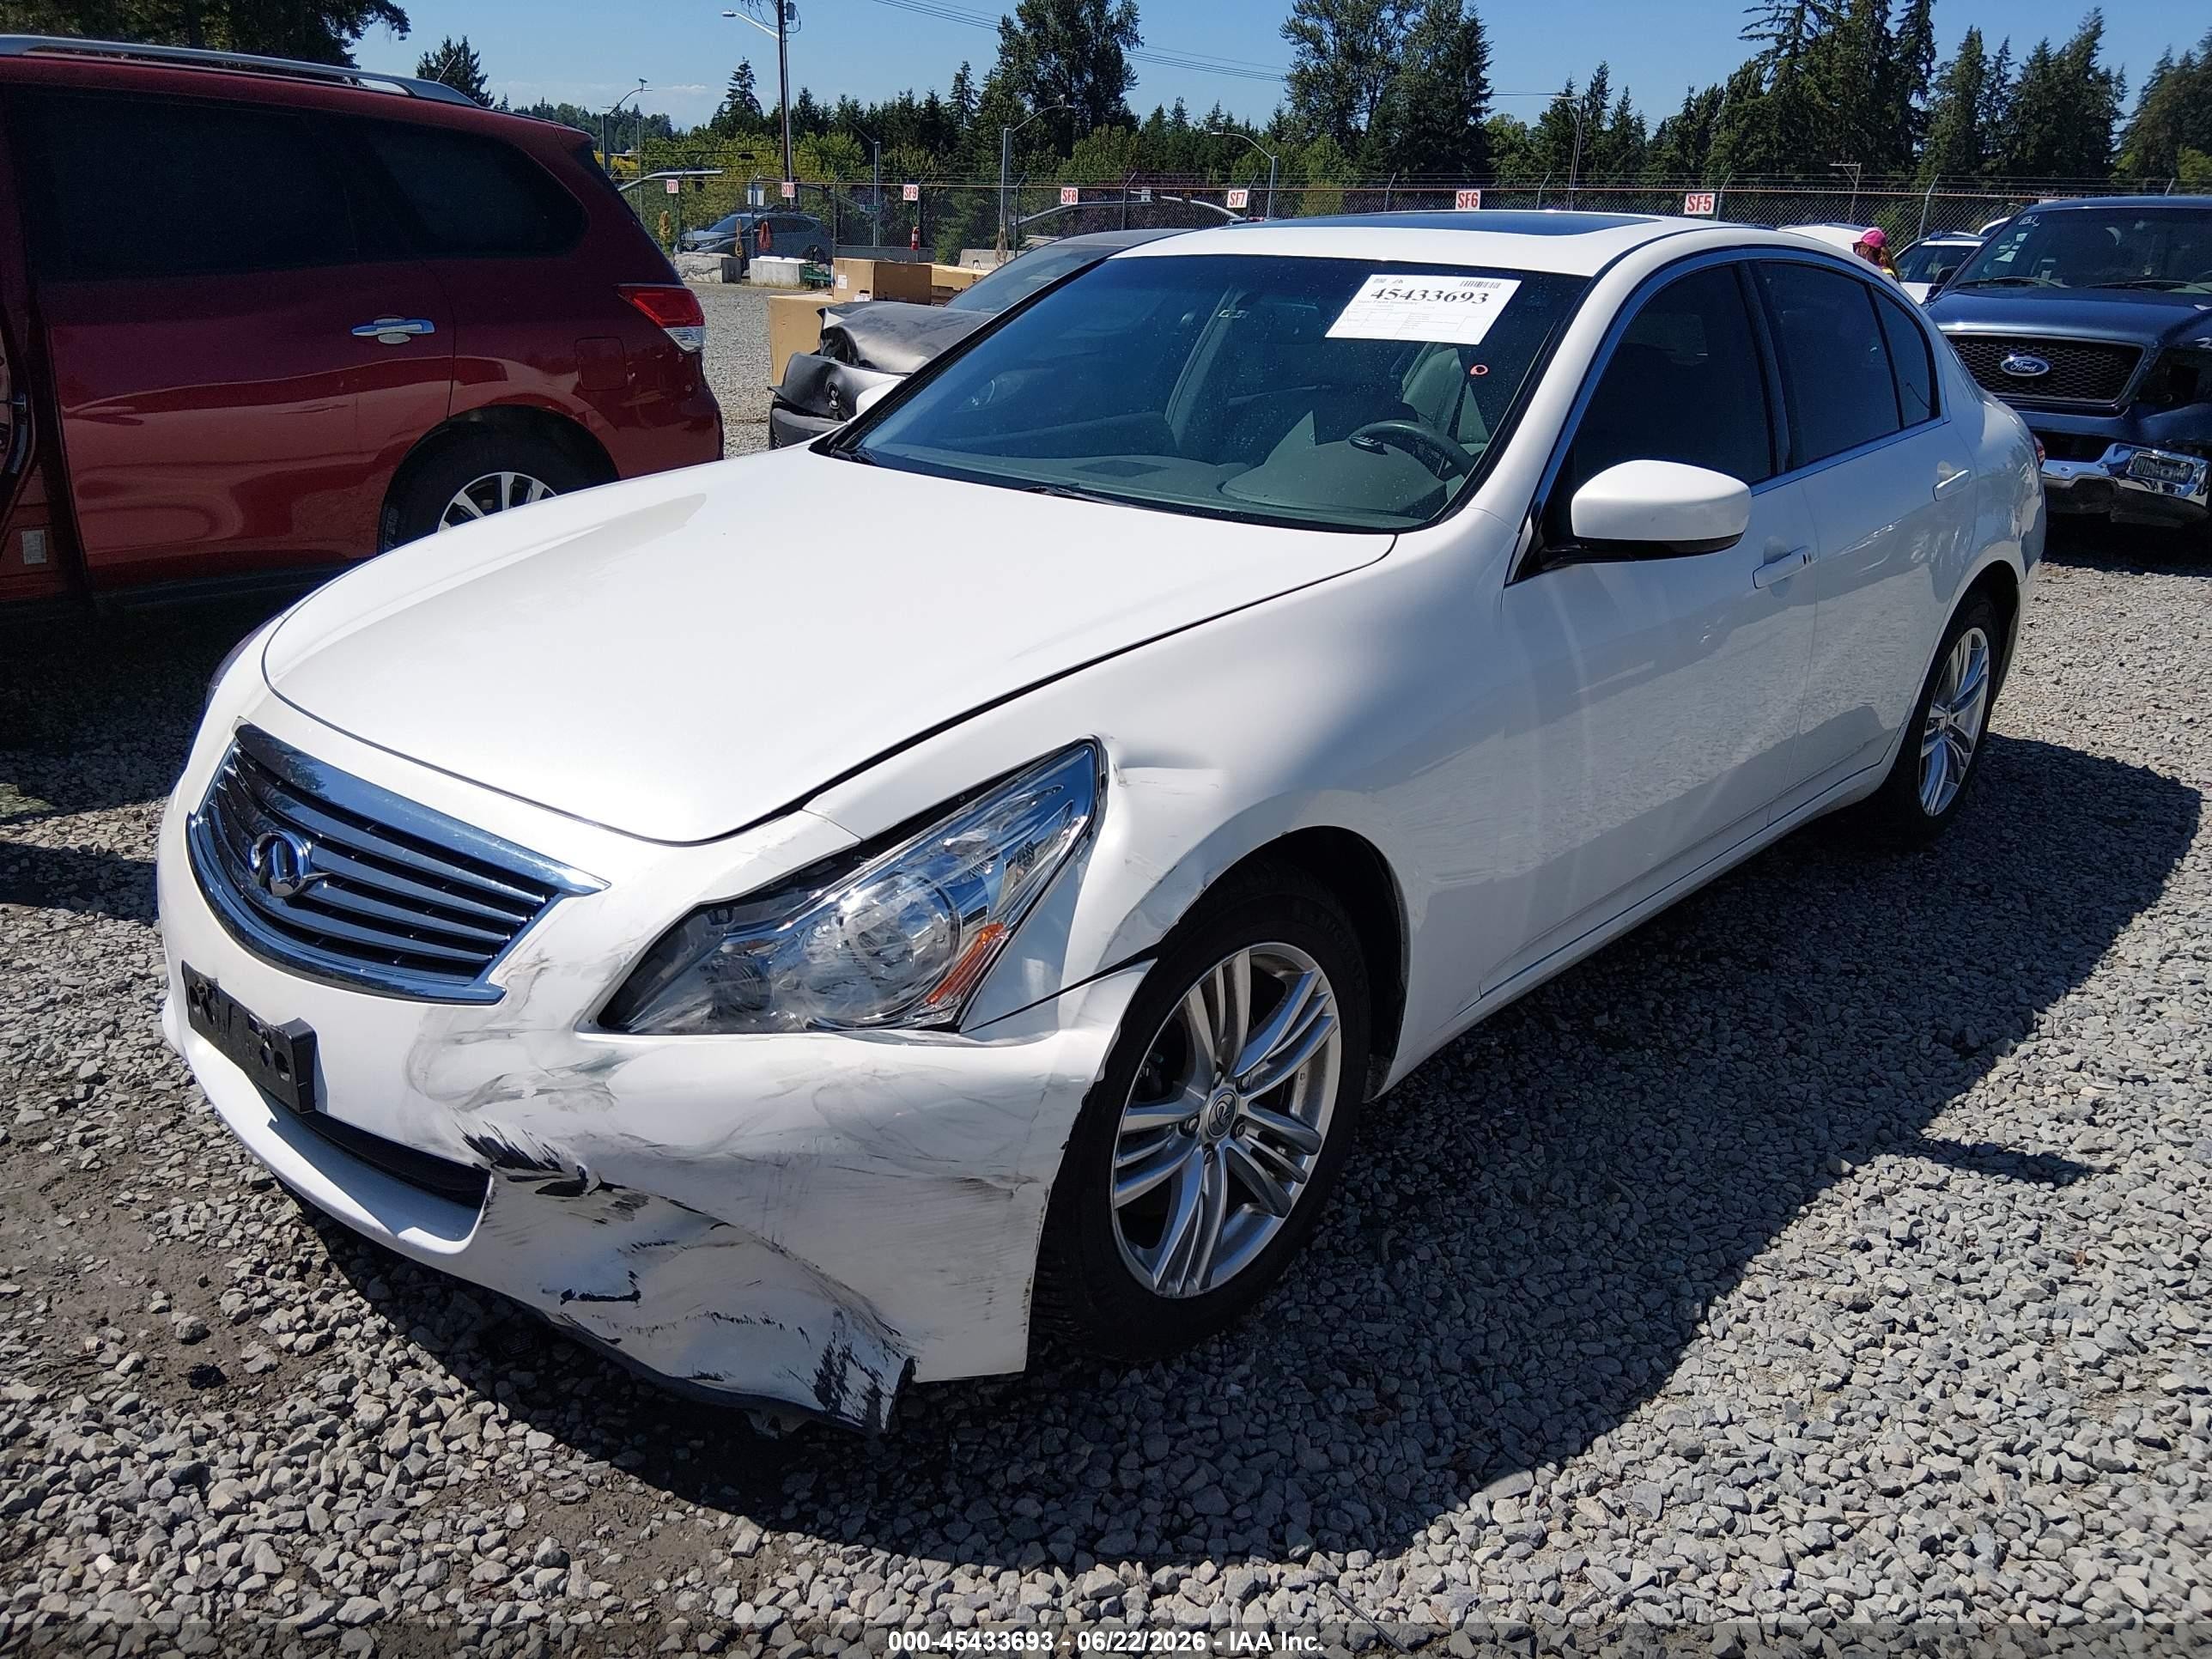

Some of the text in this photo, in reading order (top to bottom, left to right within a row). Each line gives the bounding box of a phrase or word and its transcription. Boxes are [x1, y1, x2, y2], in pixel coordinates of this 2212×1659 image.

[667, 181, 678, 192] SF11
[782, 183, 794, 197] SF10
[904, 185, 918, 199] SF9
[1061, 188, 1077, 204] SF8
[1229, 191, 1246, 207] SF7
[1457, 192, 1479, 209] SF6
[1686, 194, 1713, 212] SF5
[1370, 288, 1490, 304] 45433693
[2009, 360, 2039, 372] Ford
